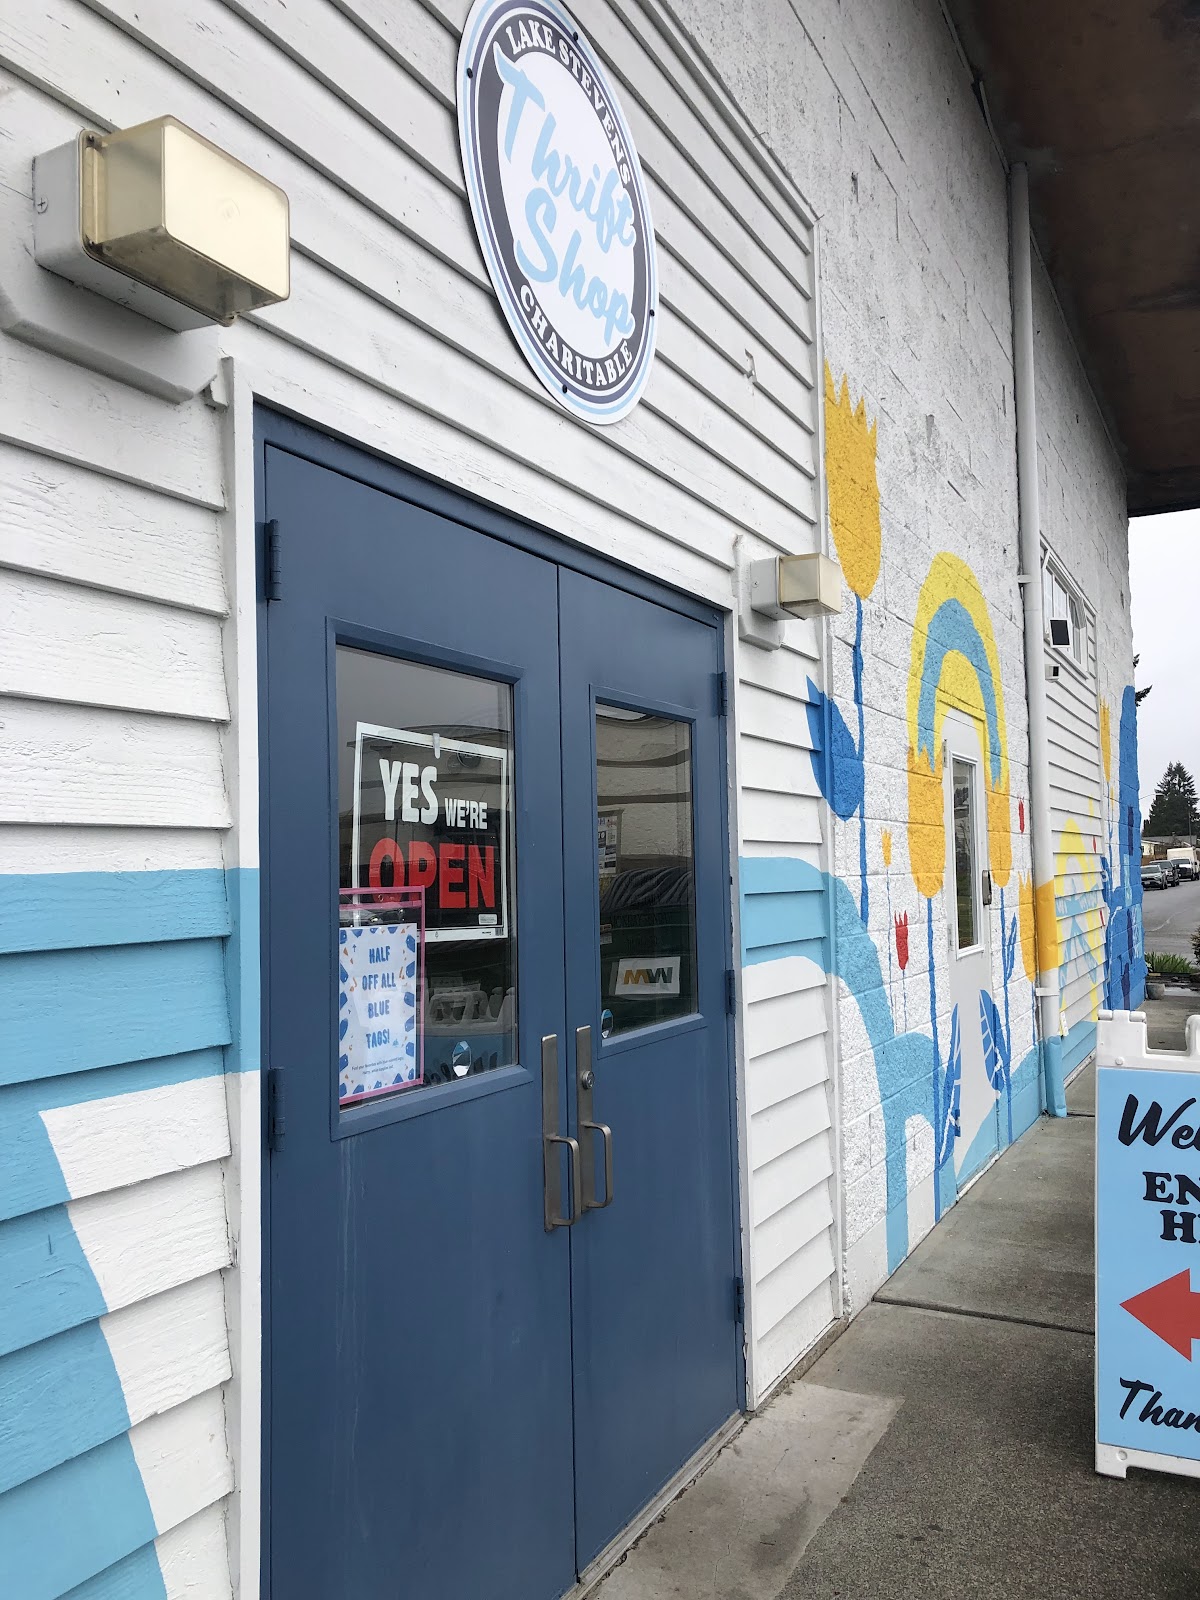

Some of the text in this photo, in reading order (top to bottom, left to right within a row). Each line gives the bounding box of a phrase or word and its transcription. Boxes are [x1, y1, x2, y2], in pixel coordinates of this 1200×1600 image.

[506, 19, 631, 185] LAKE STEVENS
[496, 46, 633, 253] Thrift
[517, 187, 632, 347] Shop
[520, 284, 633, 387] CHARITABLE
[379, 758, 488, 829] YES WE'RE
[369, 838, 495, 909] OPEN
[362, 972, 396, 990] OFF ALL
[369, 946, 390, 964] HALF
[366, 1028, 390, 1049] TAGS!
[368, 999, 390, 1019] BLUE
[1159, 1209, 1200, 1243] H
